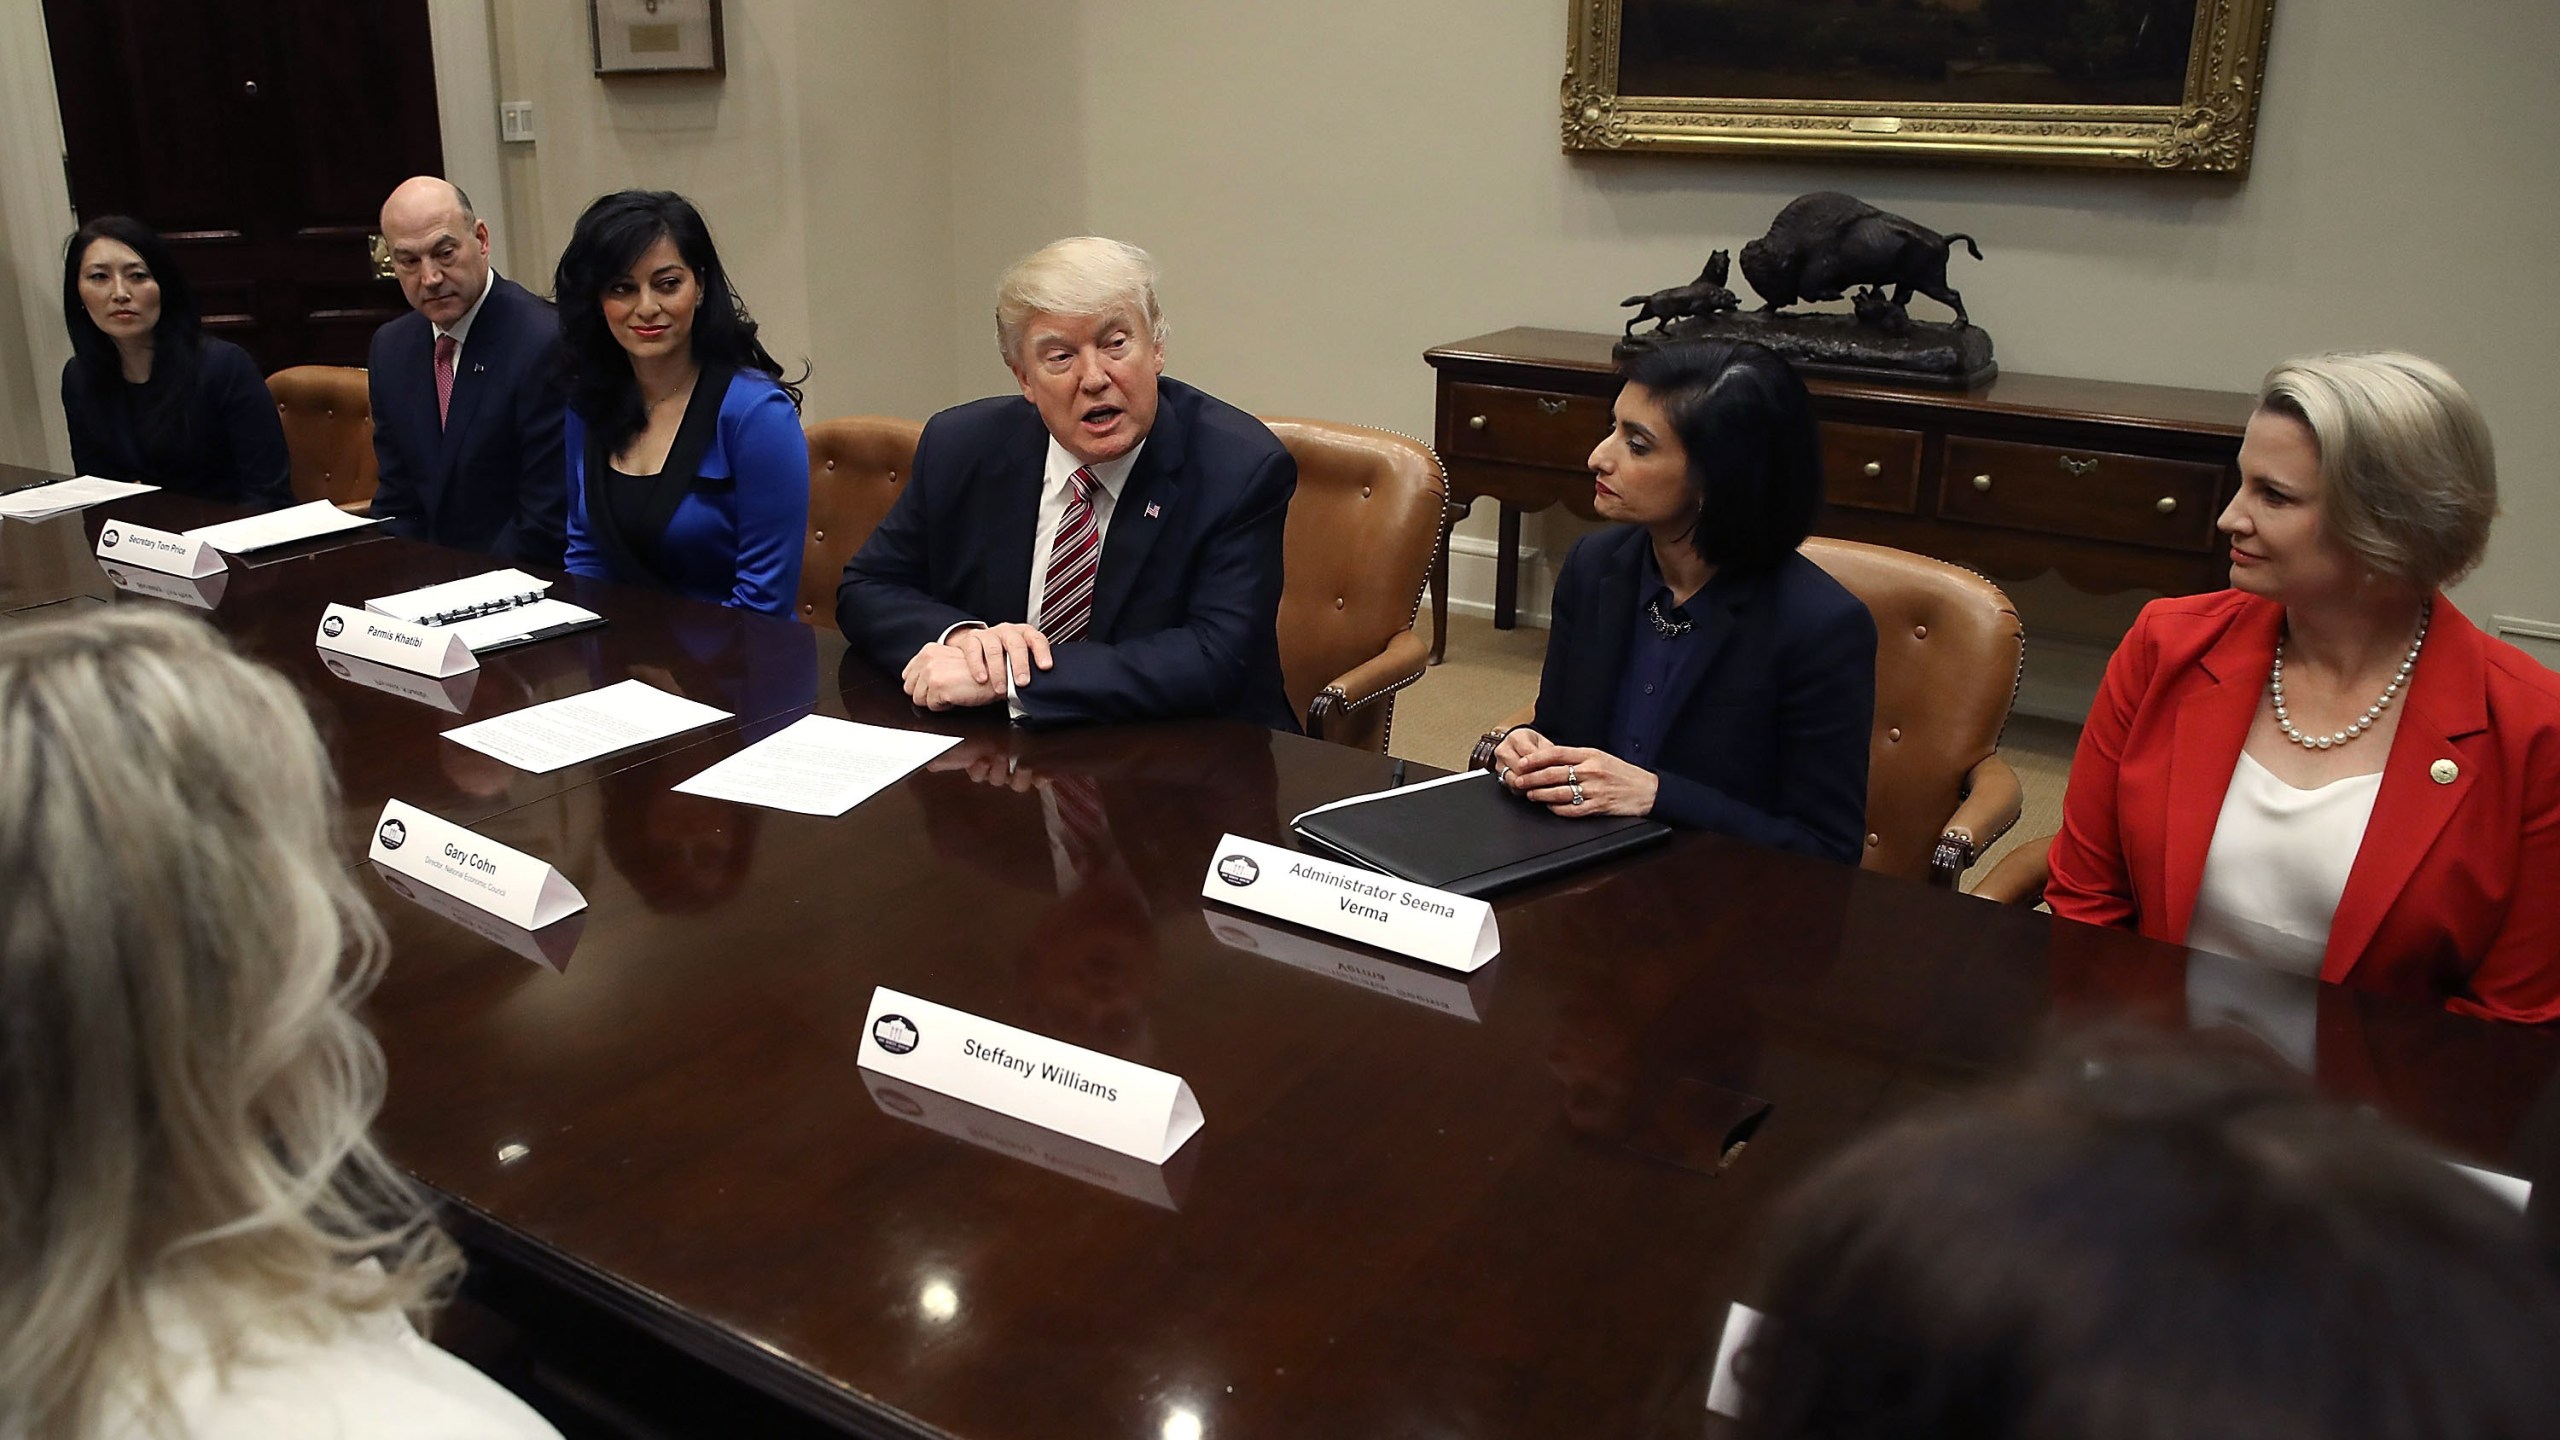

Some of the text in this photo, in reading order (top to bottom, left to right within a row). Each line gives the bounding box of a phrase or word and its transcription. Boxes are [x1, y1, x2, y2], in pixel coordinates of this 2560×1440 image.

[128, 534, 187, 556] Secretary Tom Price
[367, 625, 424, 648] Parmis Khatibi
[444, 842, 497, 876] Gary Cohn
[444, 864, 464, 880] National
[463, 872, 488, 889] Economic
[487, 883, 506, 897] Council
[1289, 862, 1455, 919] Administrator Seema
[1339, 896, 1389, 923] Verma
[963, 1038, 1118, 1102] Steffany Williams
